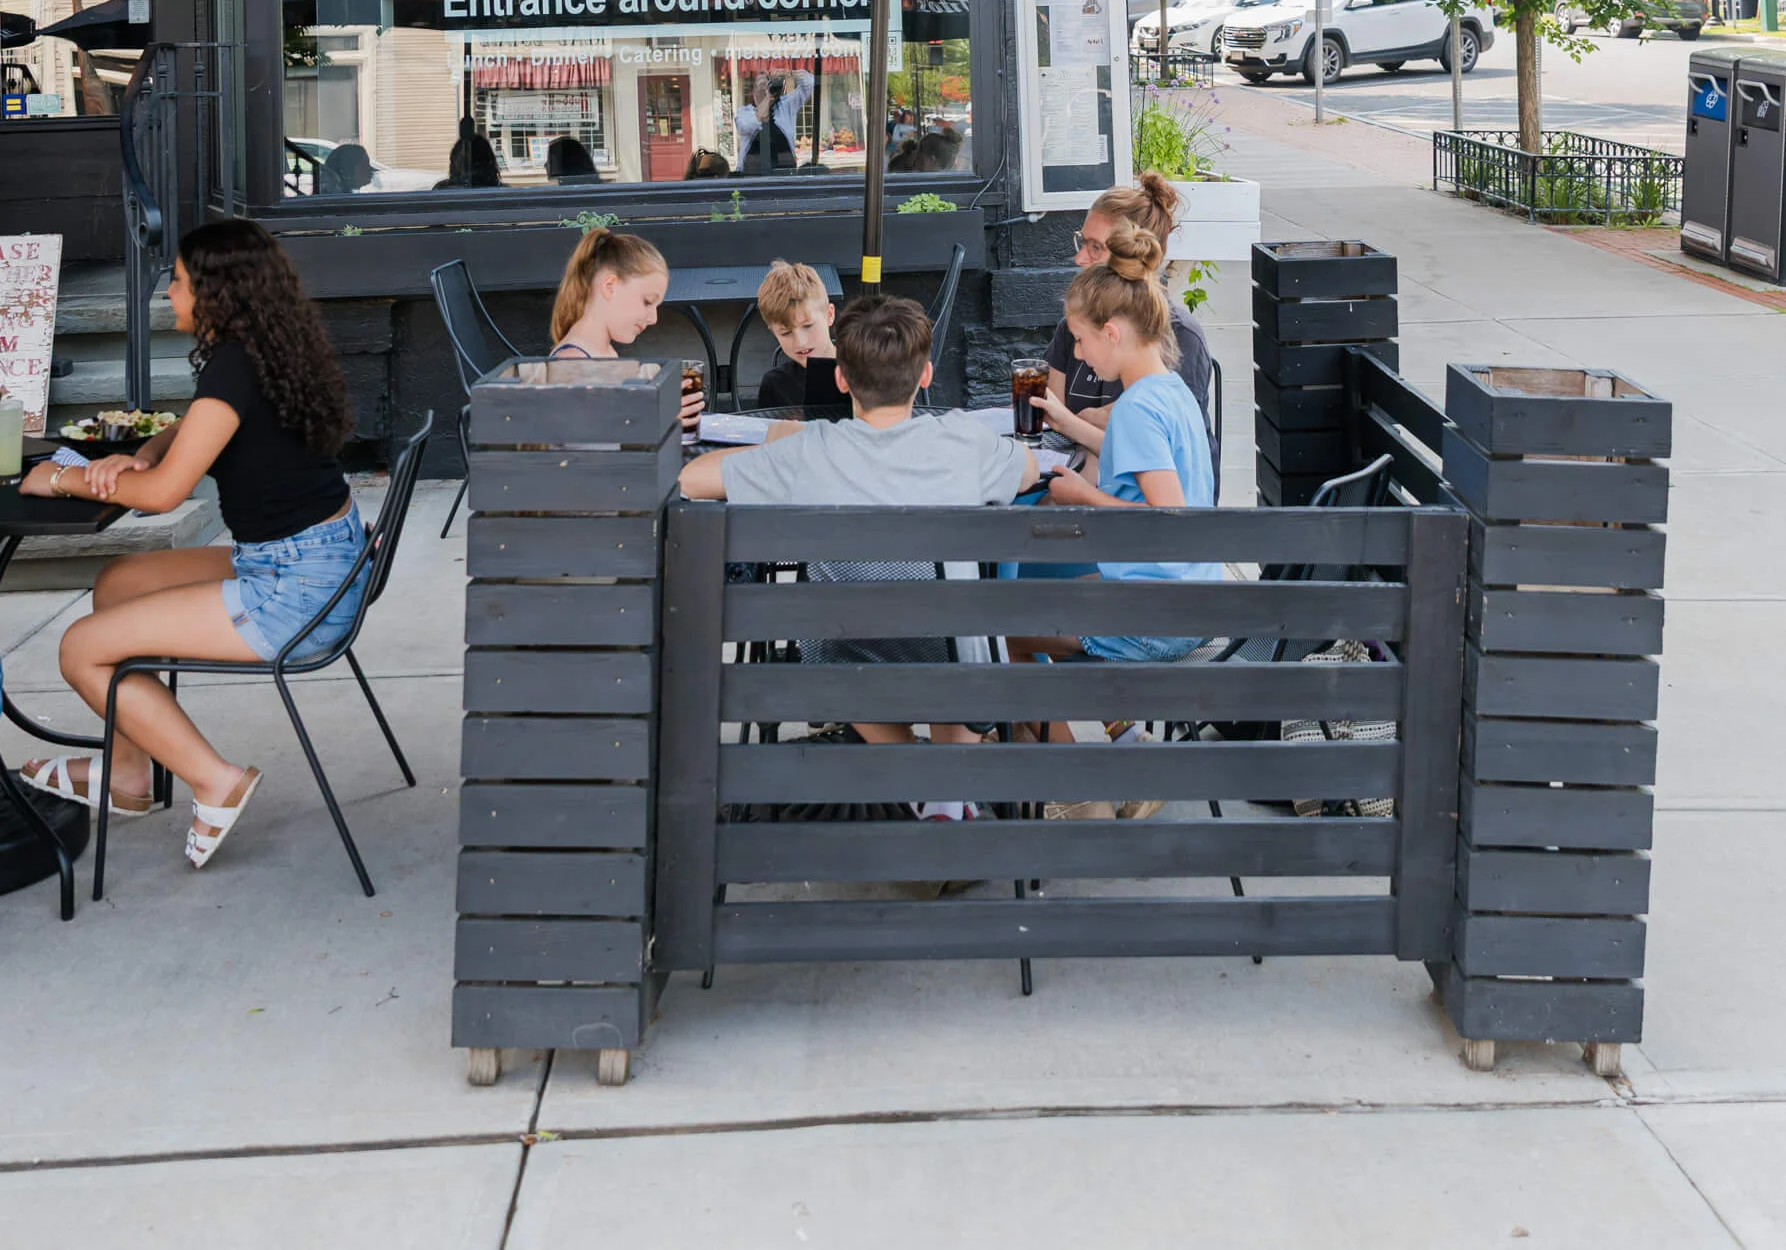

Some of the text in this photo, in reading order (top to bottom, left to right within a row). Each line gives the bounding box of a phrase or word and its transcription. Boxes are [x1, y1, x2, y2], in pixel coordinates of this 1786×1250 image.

[531, 48, 595, 66] Dinner
[618, 45, 702, 66] Catering
[725, 41, 861, 61] melsat22.com
